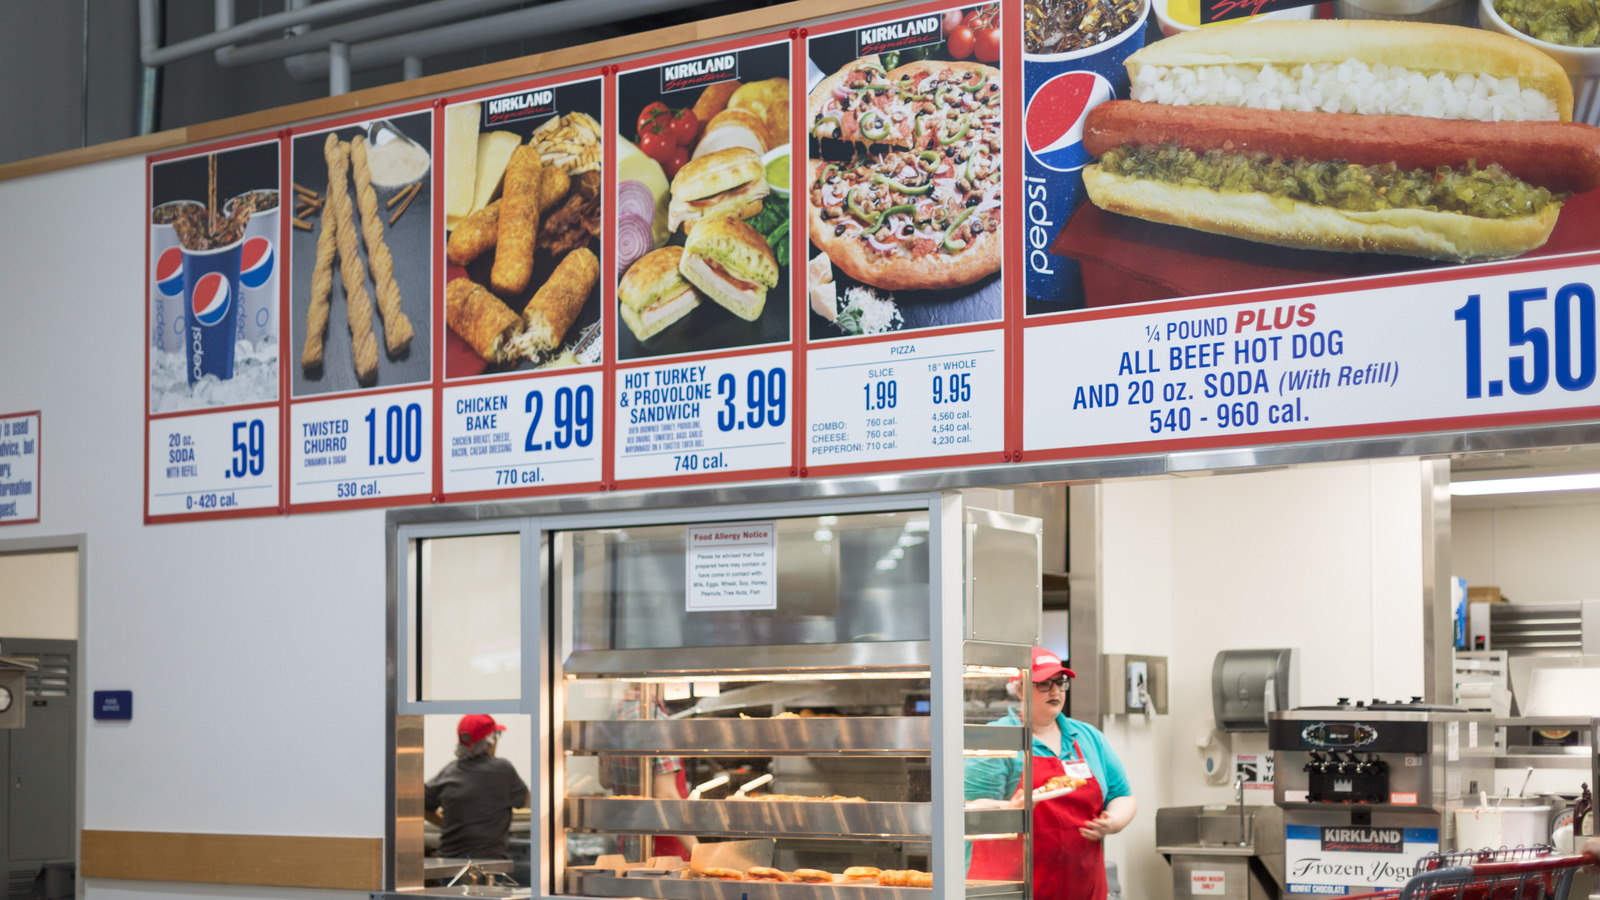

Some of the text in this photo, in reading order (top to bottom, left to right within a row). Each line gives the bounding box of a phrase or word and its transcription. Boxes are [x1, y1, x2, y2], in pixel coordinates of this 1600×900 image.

[861, 17, 939, 45] KIRKLAND
[862, 36, 939, 56] Signature
[665, 55, 735, 82] KIRKLAND
[665, 73, 735, 91] Signature
[489, 90, 553, 115] KIRKLAND
[1025, 175, 1054, 275] pepsi
[1166, 317, 1228, 341] POUND
[1235, 303, 1317, 334] PLUS
[890, 345, 916, 355] PIZZA
[1454, 282, 1597, 399] 1.50
[190, 325, 204, 380] pepsi
[1118, 329, 1344, 376] ALL BEEF HOT DOG
[868, 368, 894, 379] SLICE
[943, 359, 977, 371] WHOLE
[624, 365, 706, 389] HOT TURKEY
[1072, 360, 1399, 410] AND 20 oz. SODA (With Refill)
[619, 383, 712, 407] & PROVOLONE
[717, 367, 786, 432] 3.99
[864, 380, 897, 411] 1.99
[932, 373, 971, 404] 9.95
[456, 395, 508, 415] CHICKEN
[629, 402, 700, 424] SANDWICH
[1150, 407, 1192, 434] 540
[1217, 401, 1259, 428] 960
[1268, 397, 1310, 425] cal.
[4, 421, 11, 437] is
[12, 418, 29, 436] used
[302, 419, 349, 437] TWISTED
[466, 414, 497, 431] BAKE
[524, 384, 594, 452] 2.99
[812, 410, 972, 432] COMBO: 760 cal. 4,560 cal.
[169, 433, 195, 447] 20 oz.
[365, 403, 422, 466] 1.00
[812, 422, 972, 444] CHEESE: 760 cal. 4,540 cal.
[23, 437, 34, 455] but
[169, 448, 195, 463] SODA
[225, 419, 265, 478] .59
[304, 436, 347, 454] CHURRO
[812, 434, 972, 455] PEPPERONI: 710 cal. 4,230 cal.
[166, 465, 198, 479] WITH REFILL
[674, 452, 728, 471] 740 cal.
[496, 467, 545, 485] 770 cal.
[220, 492, 238, 507] cal.
[337, 480, 381, 498] 530 cal.
[694, 530, 768, 541] Food Allergy Notice
[1324, 828, 1401, 844] KIRKLAND
[1292, 857, 1422, 882] Frozen Yogu
